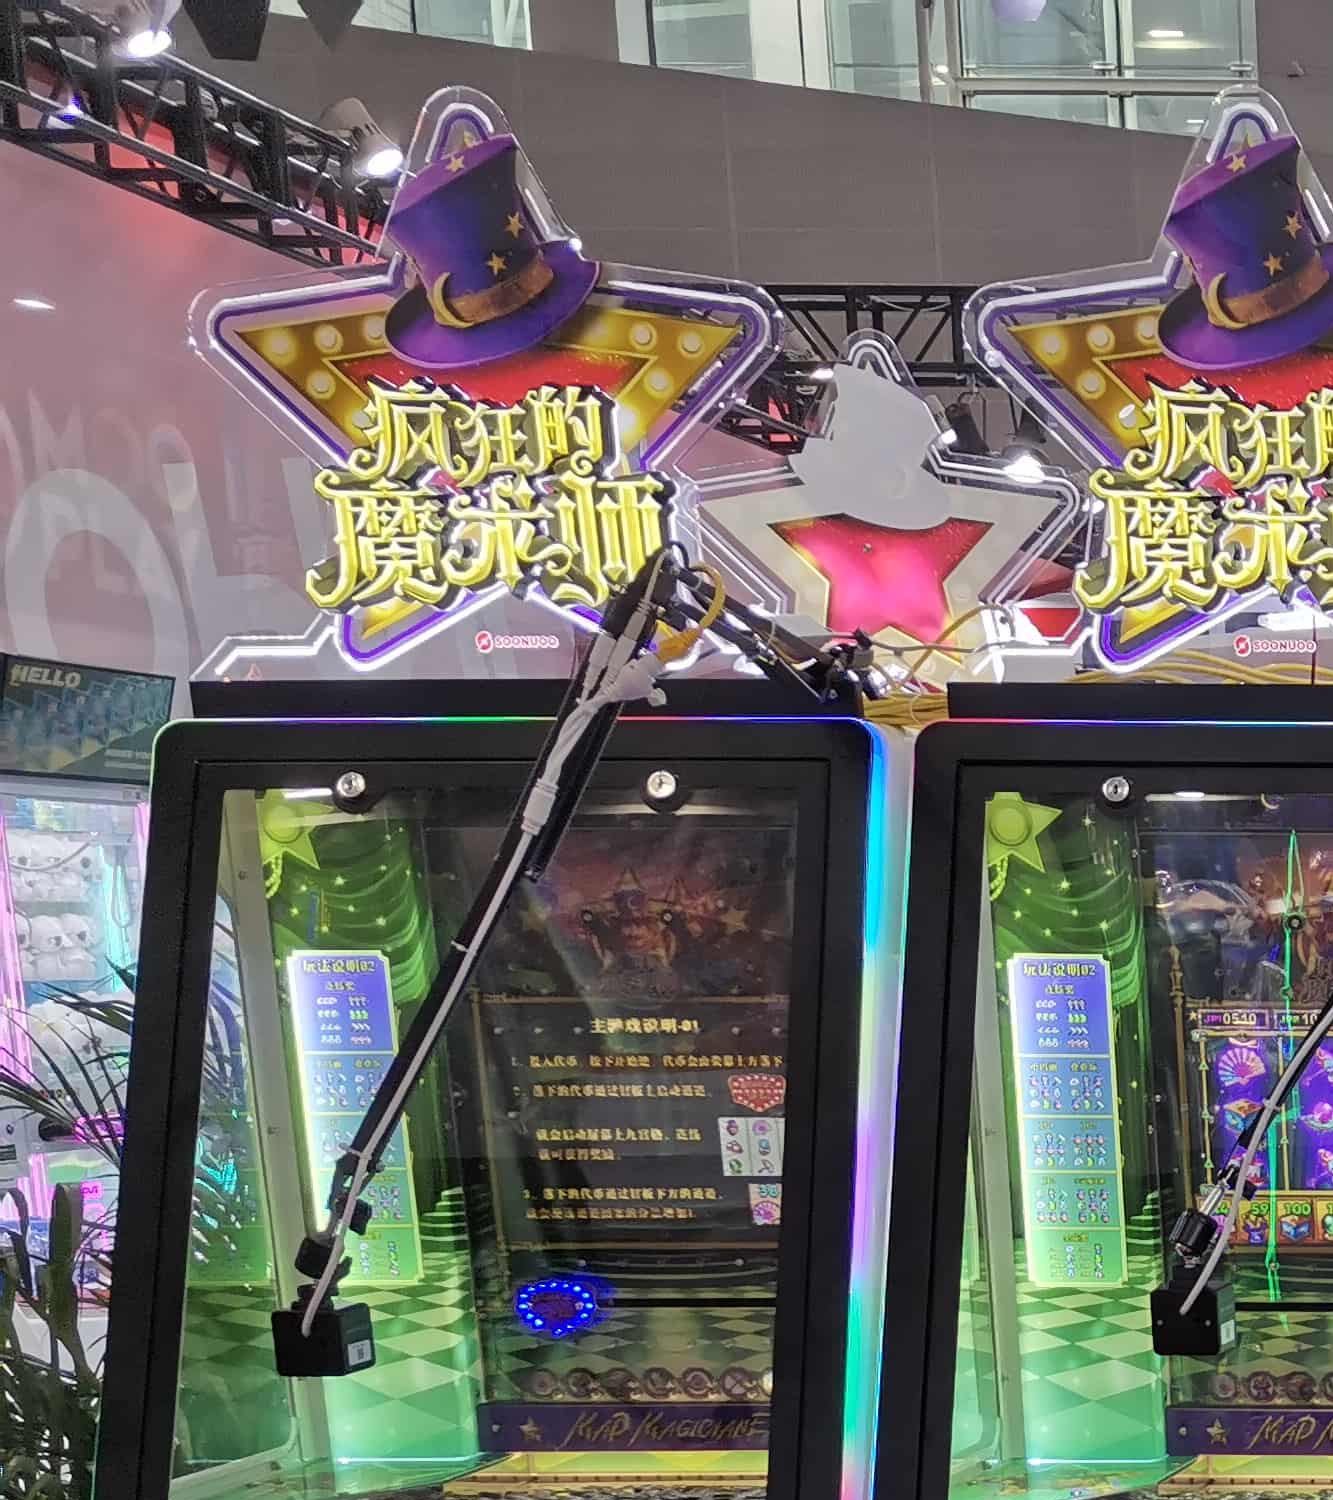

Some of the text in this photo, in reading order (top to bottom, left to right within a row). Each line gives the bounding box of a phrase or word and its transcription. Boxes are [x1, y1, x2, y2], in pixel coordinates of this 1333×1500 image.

[349, 380, 606, 478] 疯狂的
[307, 468, 665, 609] 魔术师
[1284, 1203, 1312, 1216] 100
